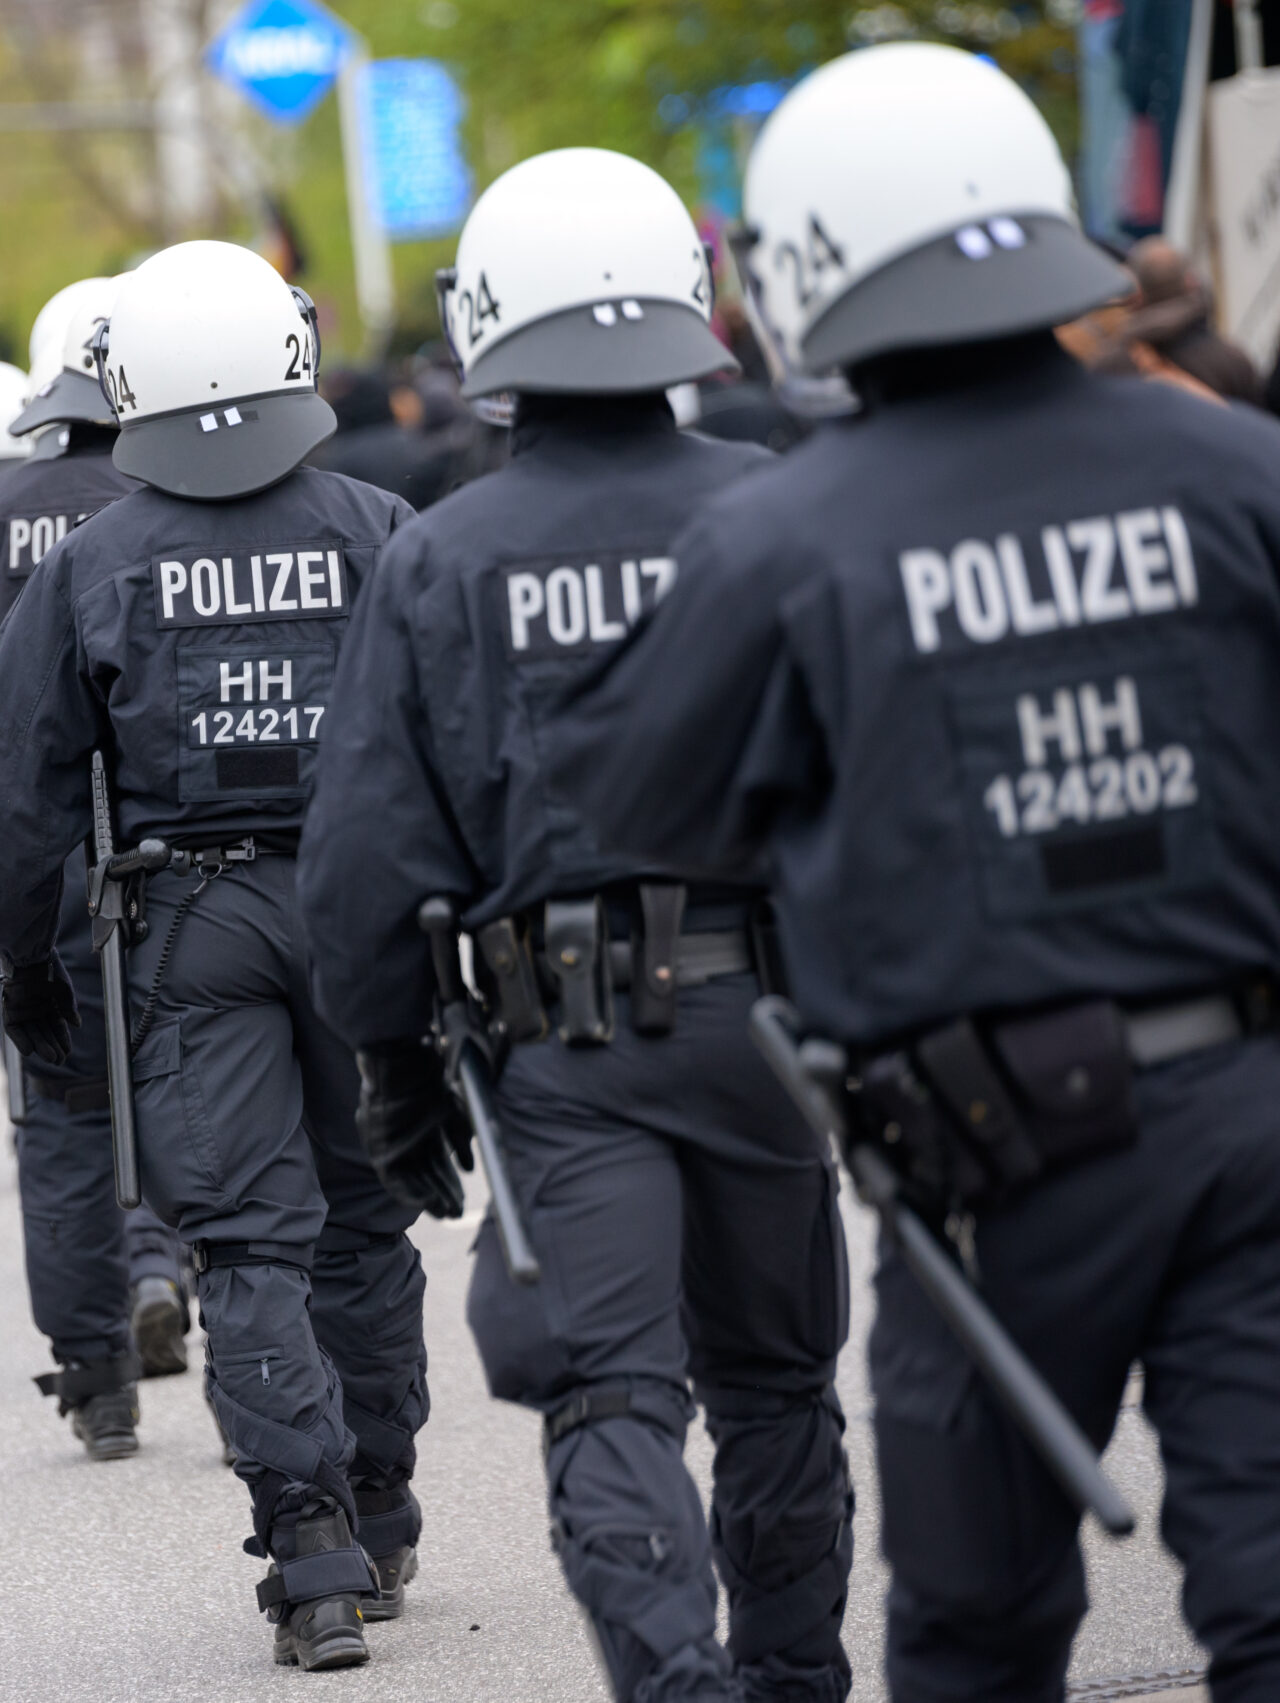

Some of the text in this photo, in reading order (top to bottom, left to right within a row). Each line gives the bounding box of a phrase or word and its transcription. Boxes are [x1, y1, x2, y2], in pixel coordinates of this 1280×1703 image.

[774, 212, 844, 306] 24
[459, 268, 500, 347] 24
[108, 365, 137, 414] 24
[284, 333, 311, 381] 24
[160, 551, 342, 618] POLIZEI
[899, 506, 1198, 653] POLIZEI
[220, 660, 292, 702] HH
[192, 706, 325, 745] 124217
[1017, 675, 1142, 767] HH
[984, 744, 1197, 837] 124202
